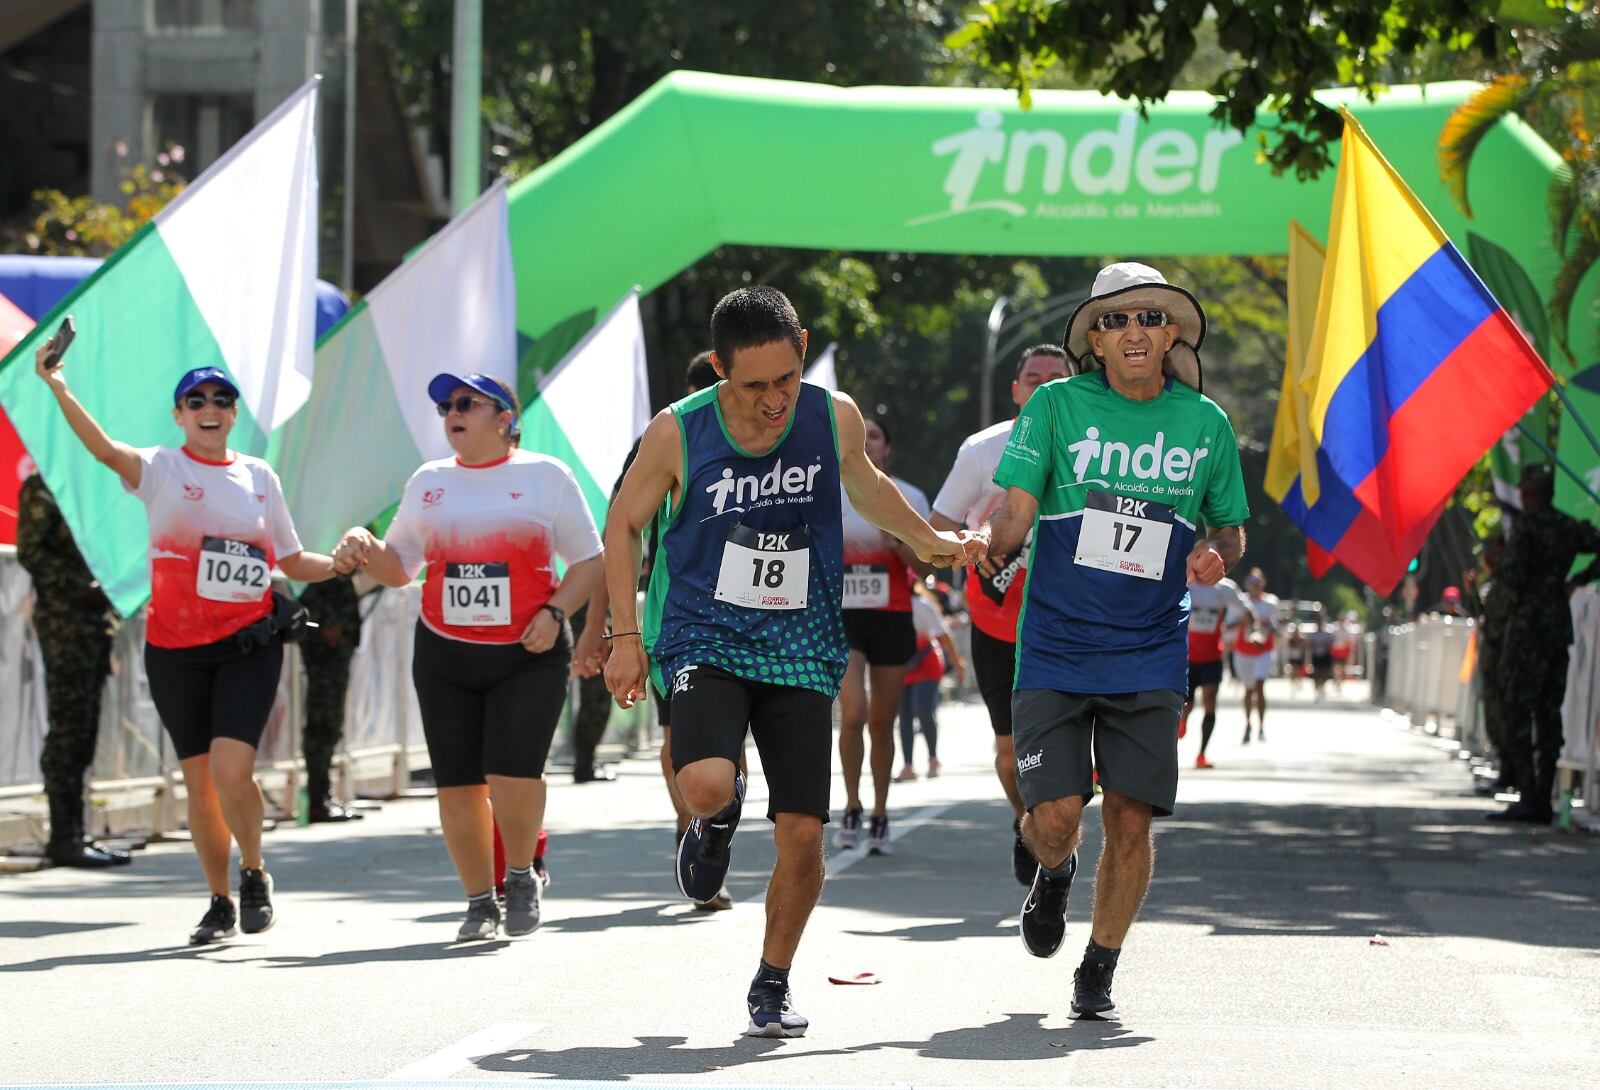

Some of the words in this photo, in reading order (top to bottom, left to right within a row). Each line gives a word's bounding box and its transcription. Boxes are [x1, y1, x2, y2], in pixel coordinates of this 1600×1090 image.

[932, 109, 1243, 212] inder
[1114, 202, 1138, 217] de
[1068, 427, 1208, 482] inder
[1114, 481, 1149, 493] Alcaldía
[1152, 485, 1164, 494] de
[775, 497, 785, 505] de
[1116, 496, 1148, 518] 12K
[757, 533, 790, 551] 12K
[1112, 521, 1142, 553] 17
[224, 540, 251, 557] 12K
[206, 559, 264, 587] 1042
[458, 564, 486, 578] 12K
[752, 558, 785, 588] 18
[448, 585, 500, 607] 1041
